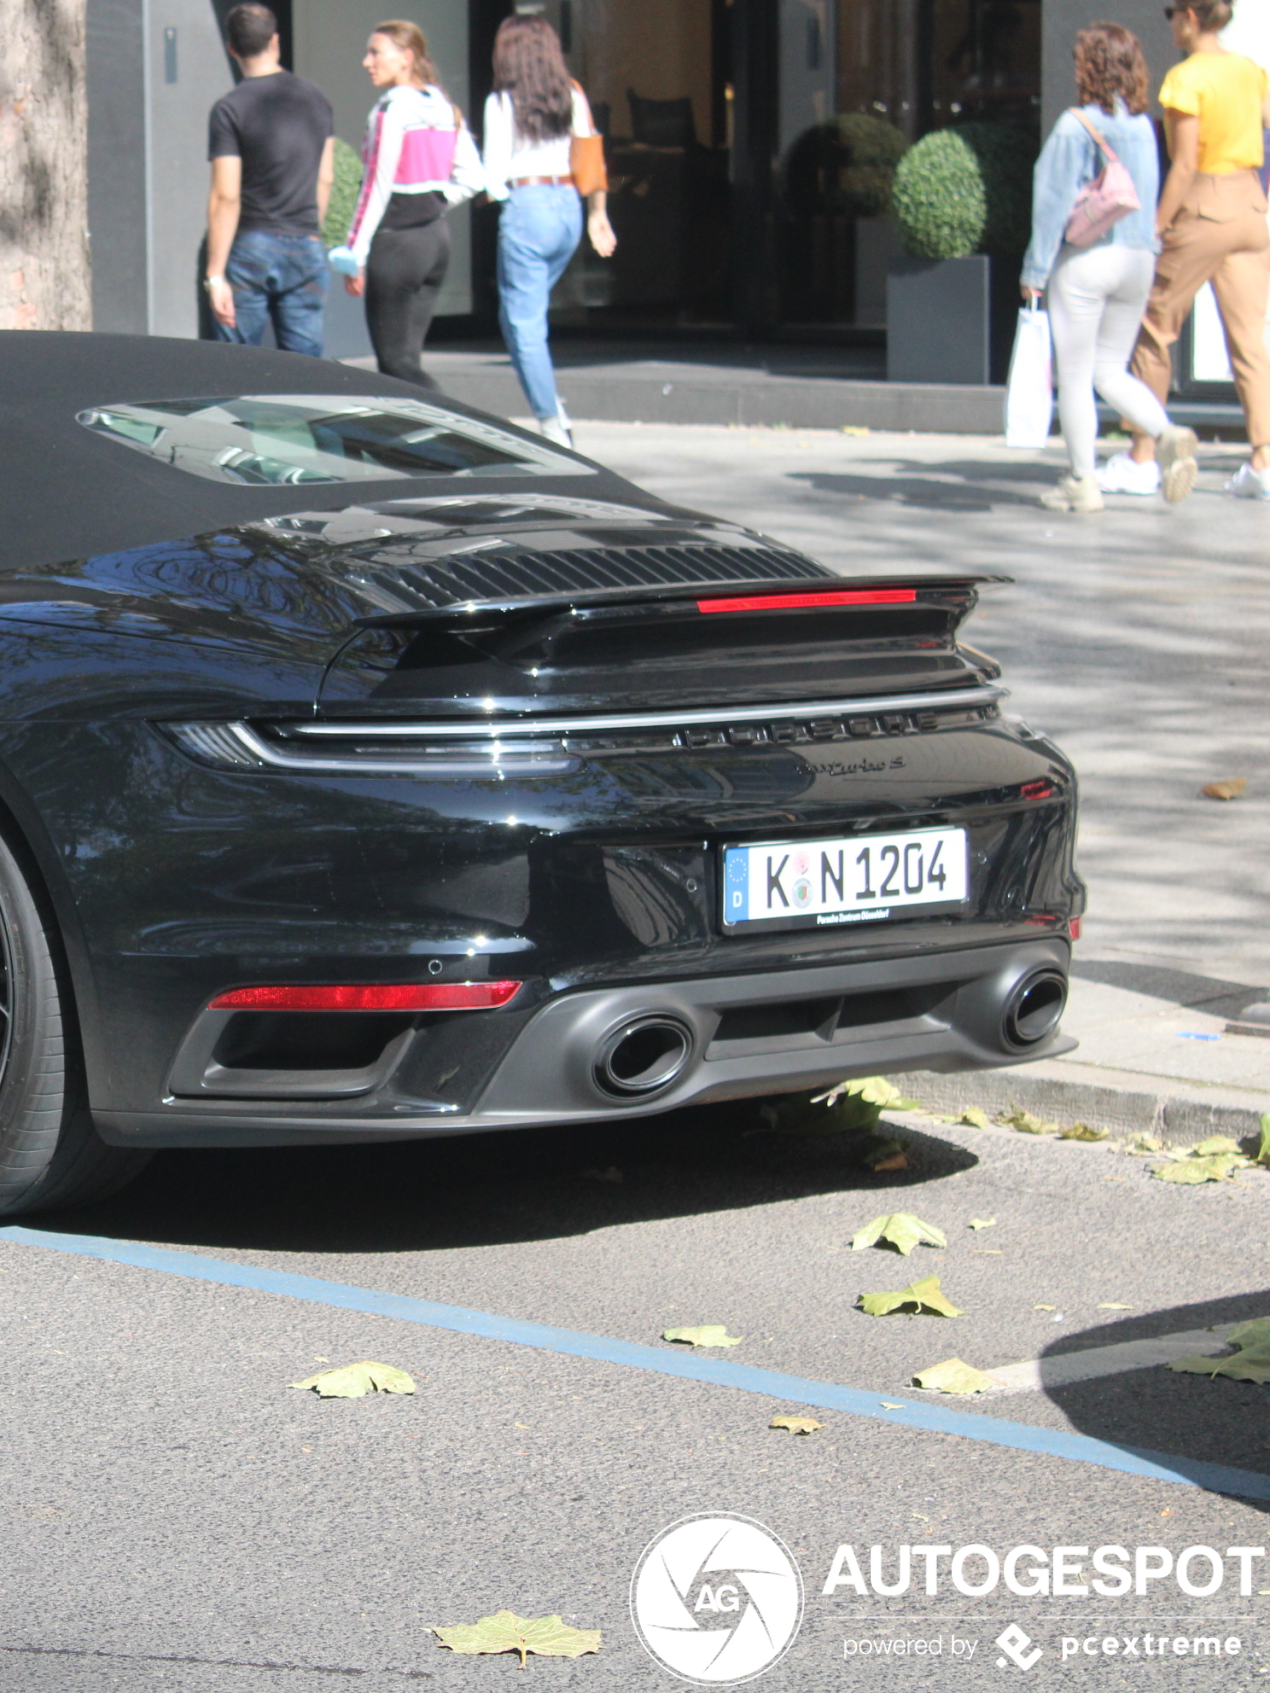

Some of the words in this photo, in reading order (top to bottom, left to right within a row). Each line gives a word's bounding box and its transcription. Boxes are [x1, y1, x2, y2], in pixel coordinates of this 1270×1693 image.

[767, 855, 790, 909] K
[821, 850, 844, 903] N
[856, 840, 947, 900] 1204
[733, 891, 742, 908] D
